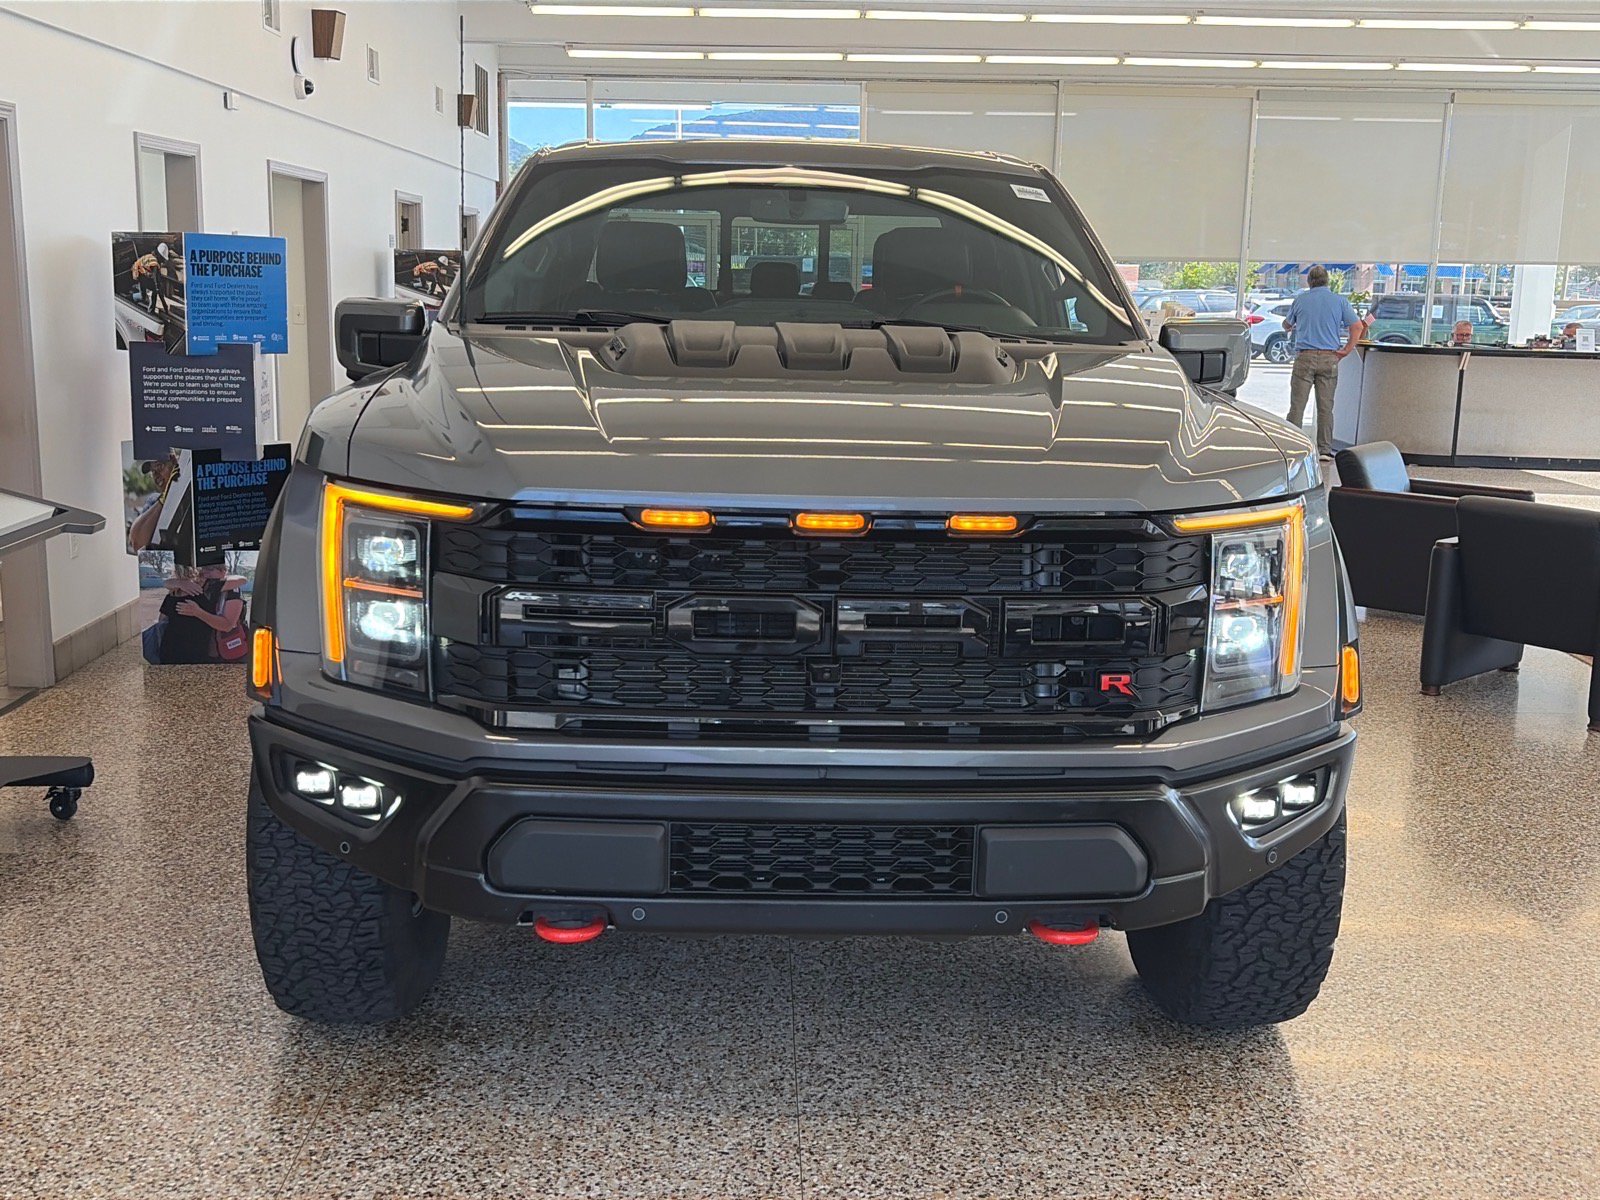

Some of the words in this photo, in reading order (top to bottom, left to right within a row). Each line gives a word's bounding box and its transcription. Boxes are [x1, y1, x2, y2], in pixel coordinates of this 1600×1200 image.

[190, 250, 197, 263] A
[199, 250, 245, 264] PURPOSE
[247, 252, 281, 265] BEHIND
[190, 263, 209, 276] THE
[212, 264, 262, 277] PURCHASE
[197, 465, 203, 477] A
[205, 462, 250, 476] PURPOSE
[252, 458, 286, 472] BEHIND
[197, 477, 215, 491] THE
[218, 472, 268, 488] PURCHASE
[495, 590, 1157, 656] FORD
[1100, 674, 1137, 697] R
